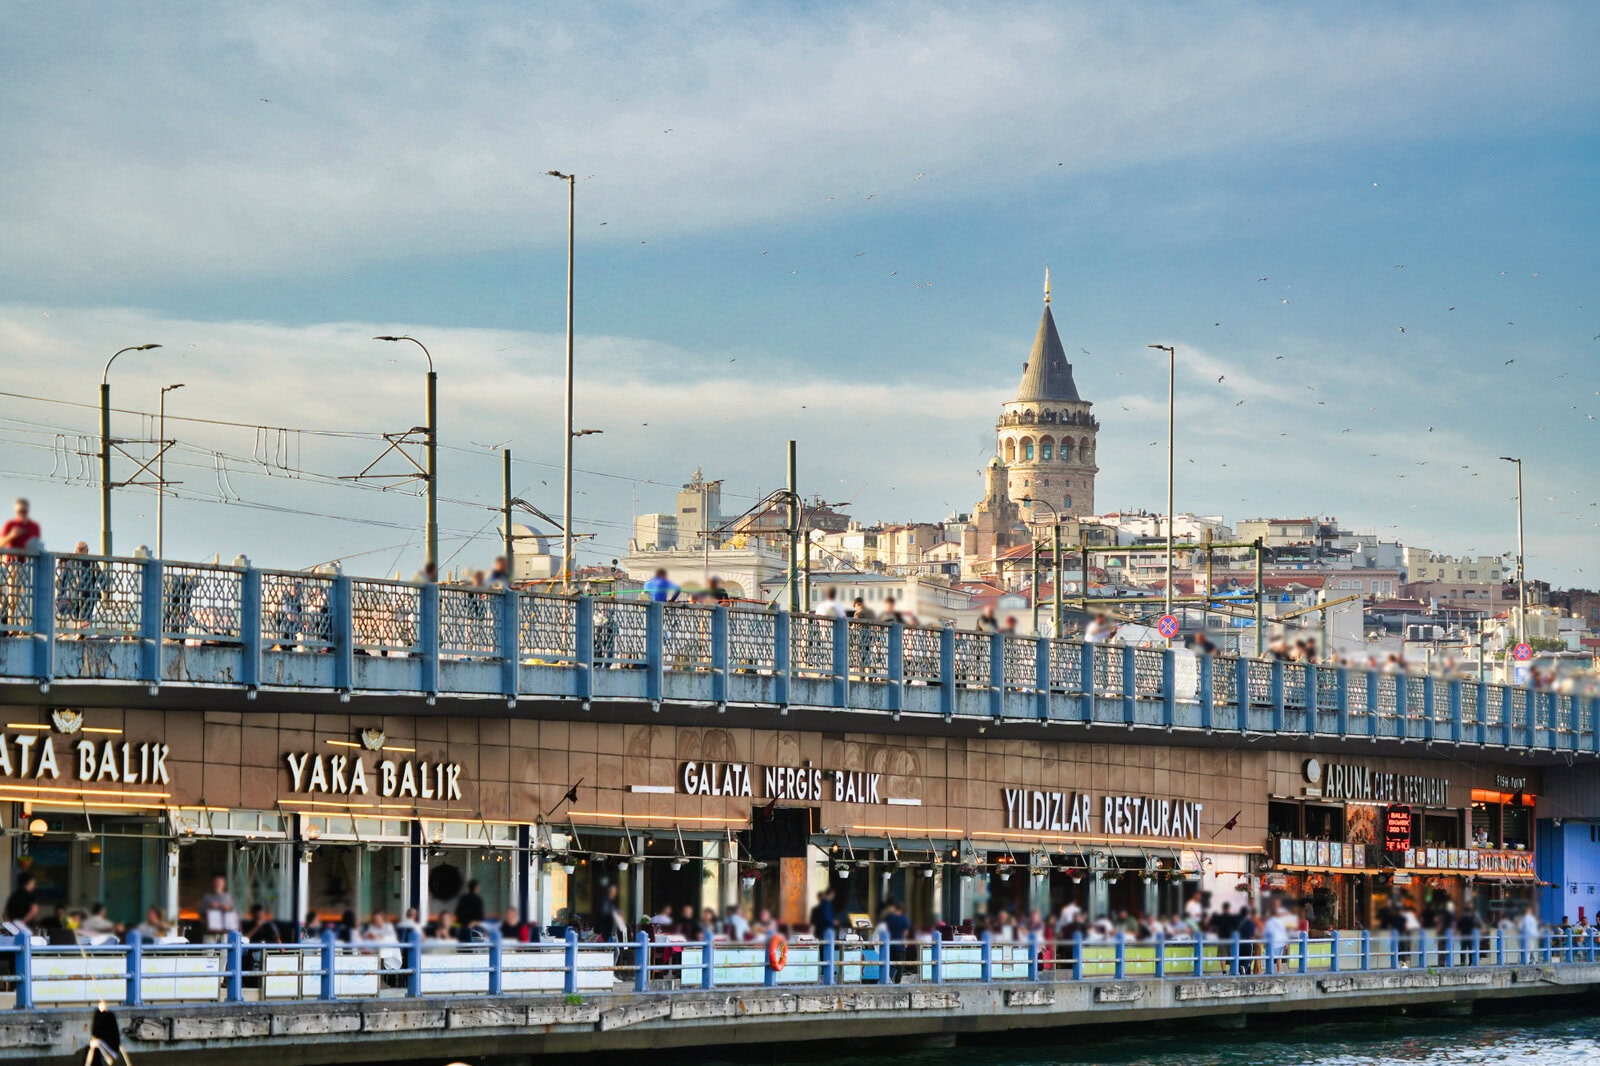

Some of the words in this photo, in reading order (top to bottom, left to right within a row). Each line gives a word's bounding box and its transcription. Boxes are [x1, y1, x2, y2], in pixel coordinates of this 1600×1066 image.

[76, 740, 171, 785] BALIK
[287, 752, 369, 795] YAKA
[380, 760, 462, 800] BALIK
[684, 761, 752, 796] GALATA
[835, 771, 880, 804] BALIK
[1326, 764, 1372, 799] ARUNA
[1374, 772, 1394, 801] CAFE
[1404, 776, 1449, 805] RESTAURANT
[1004, 788, 1091, 833] YILDIZLAR
[1104, 796, 1203, 838] RESTAURANT
